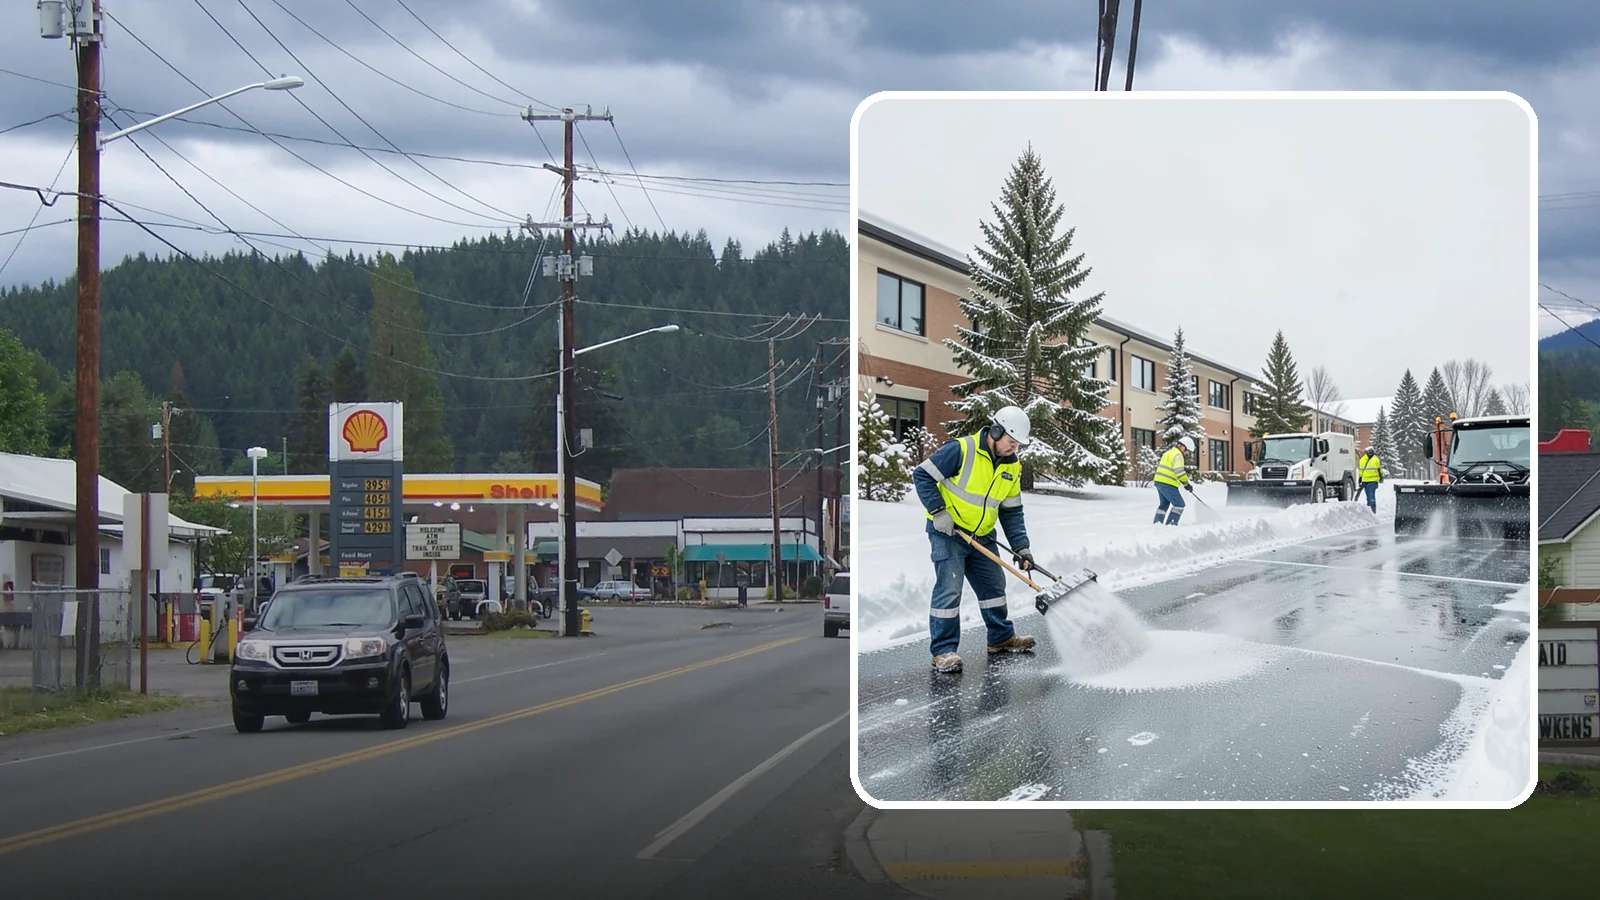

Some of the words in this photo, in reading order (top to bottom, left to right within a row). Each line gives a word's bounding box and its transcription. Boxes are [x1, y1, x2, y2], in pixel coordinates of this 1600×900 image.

[366, 480, 383, 490] 395
[490, 485, 547, 499] Shell
[366, 494, 383, 504] 405
[366, 508, 383, 518] 415
[366, 522, 383, 532] 429
